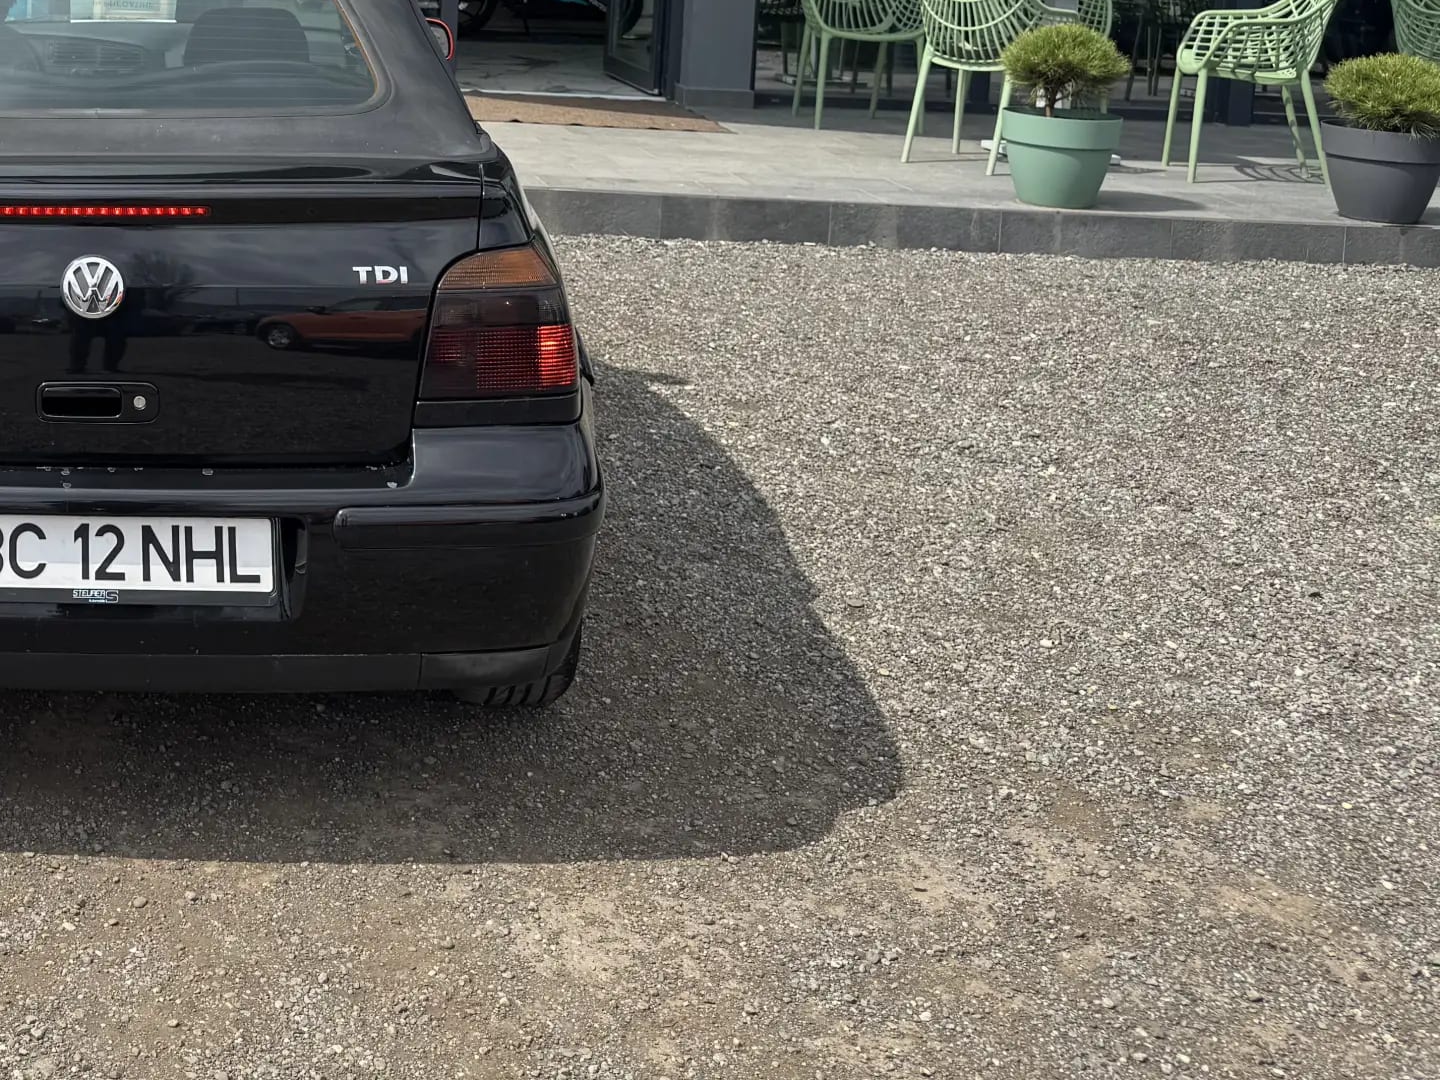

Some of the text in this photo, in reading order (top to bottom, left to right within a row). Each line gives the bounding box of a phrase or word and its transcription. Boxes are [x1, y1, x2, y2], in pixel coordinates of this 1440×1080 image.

[352, 265, 408, 284] TDI
[73, 523, 126, 581] 12
[141, 525, 261, 583] NHL
